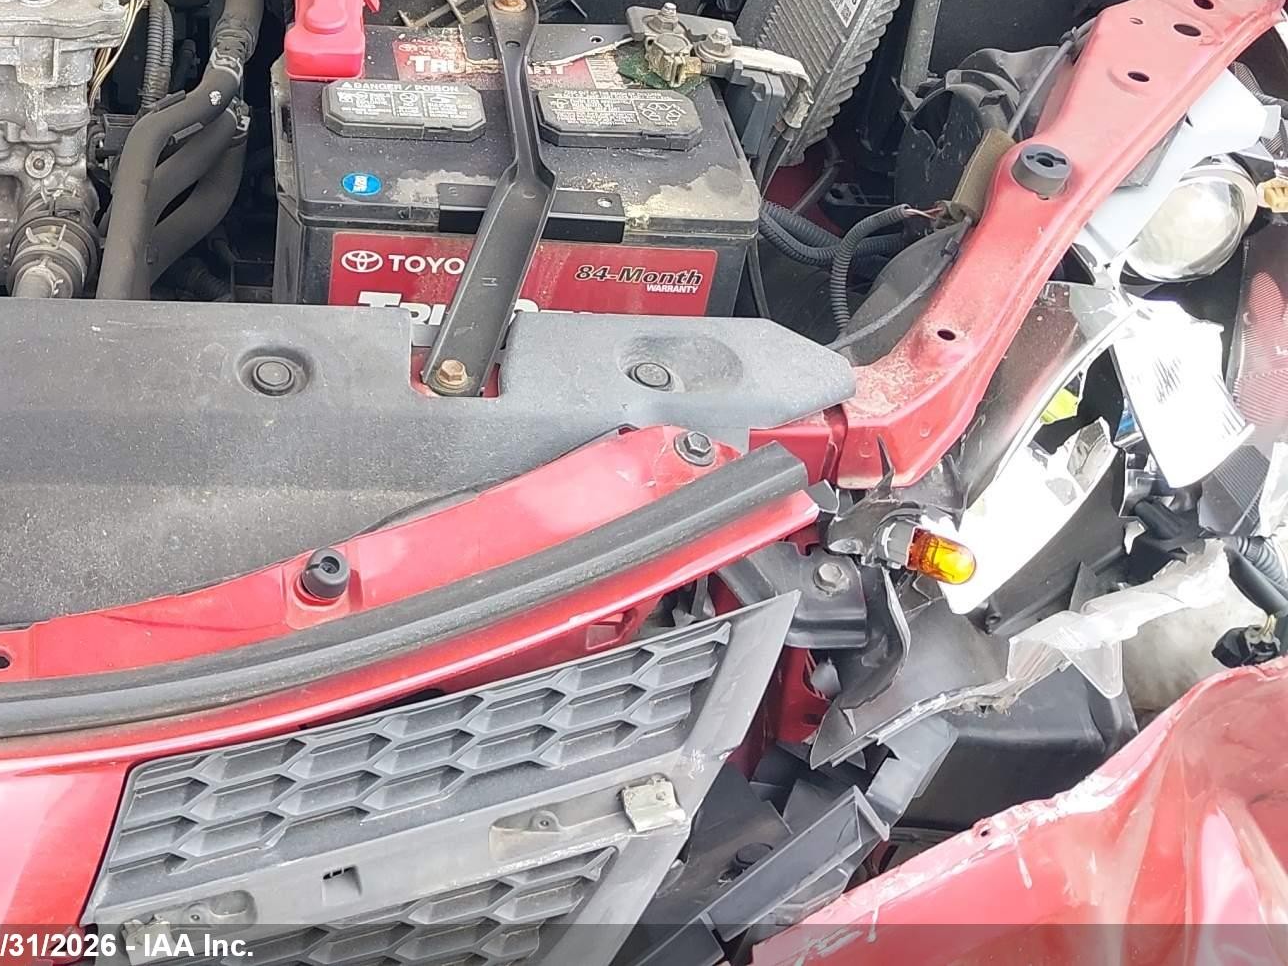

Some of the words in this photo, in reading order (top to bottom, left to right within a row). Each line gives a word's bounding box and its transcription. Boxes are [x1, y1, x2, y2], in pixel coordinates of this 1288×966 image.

[354, 82, 402, 91] DANGER
[414, 84, 459, 92] POISON
[574, 265, 703, 286] 84-Month
[646, 283, 699, 294] WARRANTY
